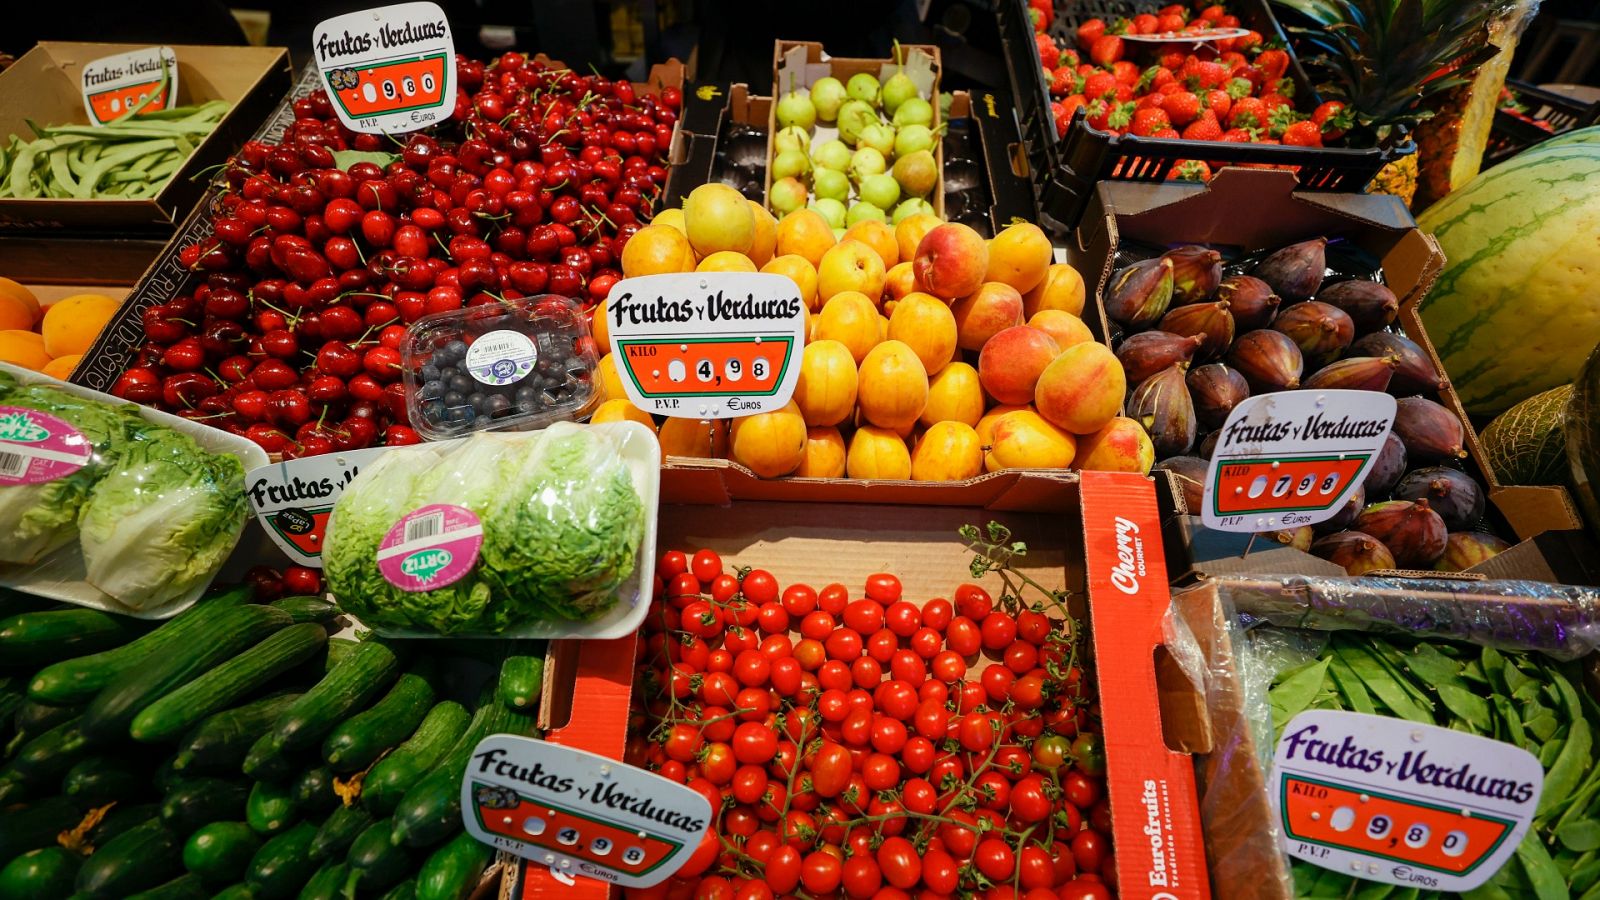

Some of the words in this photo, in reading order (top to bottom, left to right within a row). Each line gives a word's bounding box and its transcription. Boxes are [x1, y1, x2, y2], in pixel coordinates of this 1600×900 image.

[316, 30, 372, 62] Frutas
[379, 20, 446, 48] Verduras
[84, 67, 123, 87] Frutas
[384, 77, 433, 103] 9,80
[360, 118, 378, 128] P.V.P.
[165, 254, 187, 281] DE
[608, 292, 694, 327] Frutas
[707, 290, 801, 321] Verduras
[111, 325, 137, 353] DE
[629, 346, 657, 357] KILO
[86, 345, 124, 391] SOTO
[698, 360, 764, 386] 4,98
[655, 399, 680, 409] P.V.P.
[1224, 415, 1293, 448] Frutas
[1302, 412, 1388, 441] Verduras
[1223, 466, 1250, 478] KILO
[248, 477, 334, 508] Frutas
[1276, 477, 1335, 500] 7,98
[404, 551, 449, 573] ORTIZ
[1111, 516, 1139, 595] Cherry
[1134, 537, 1146, 577] GOURMET
[1284, 724, 1384, 773] Frutas
[1397, 750, 1534, 804] Verduras
[474, 749, 575, 793] Frutas
[590, 781, 706, 834] Verduras
[1160, 780, 1173, 830] Artesanal
[1292, 783, 1328, 799] KILO
[560, 828, 640, 862] 4,98
[1141, 780, 1167, 887] Eurofruits
[1369, 816, 1458, 849] 9,80
